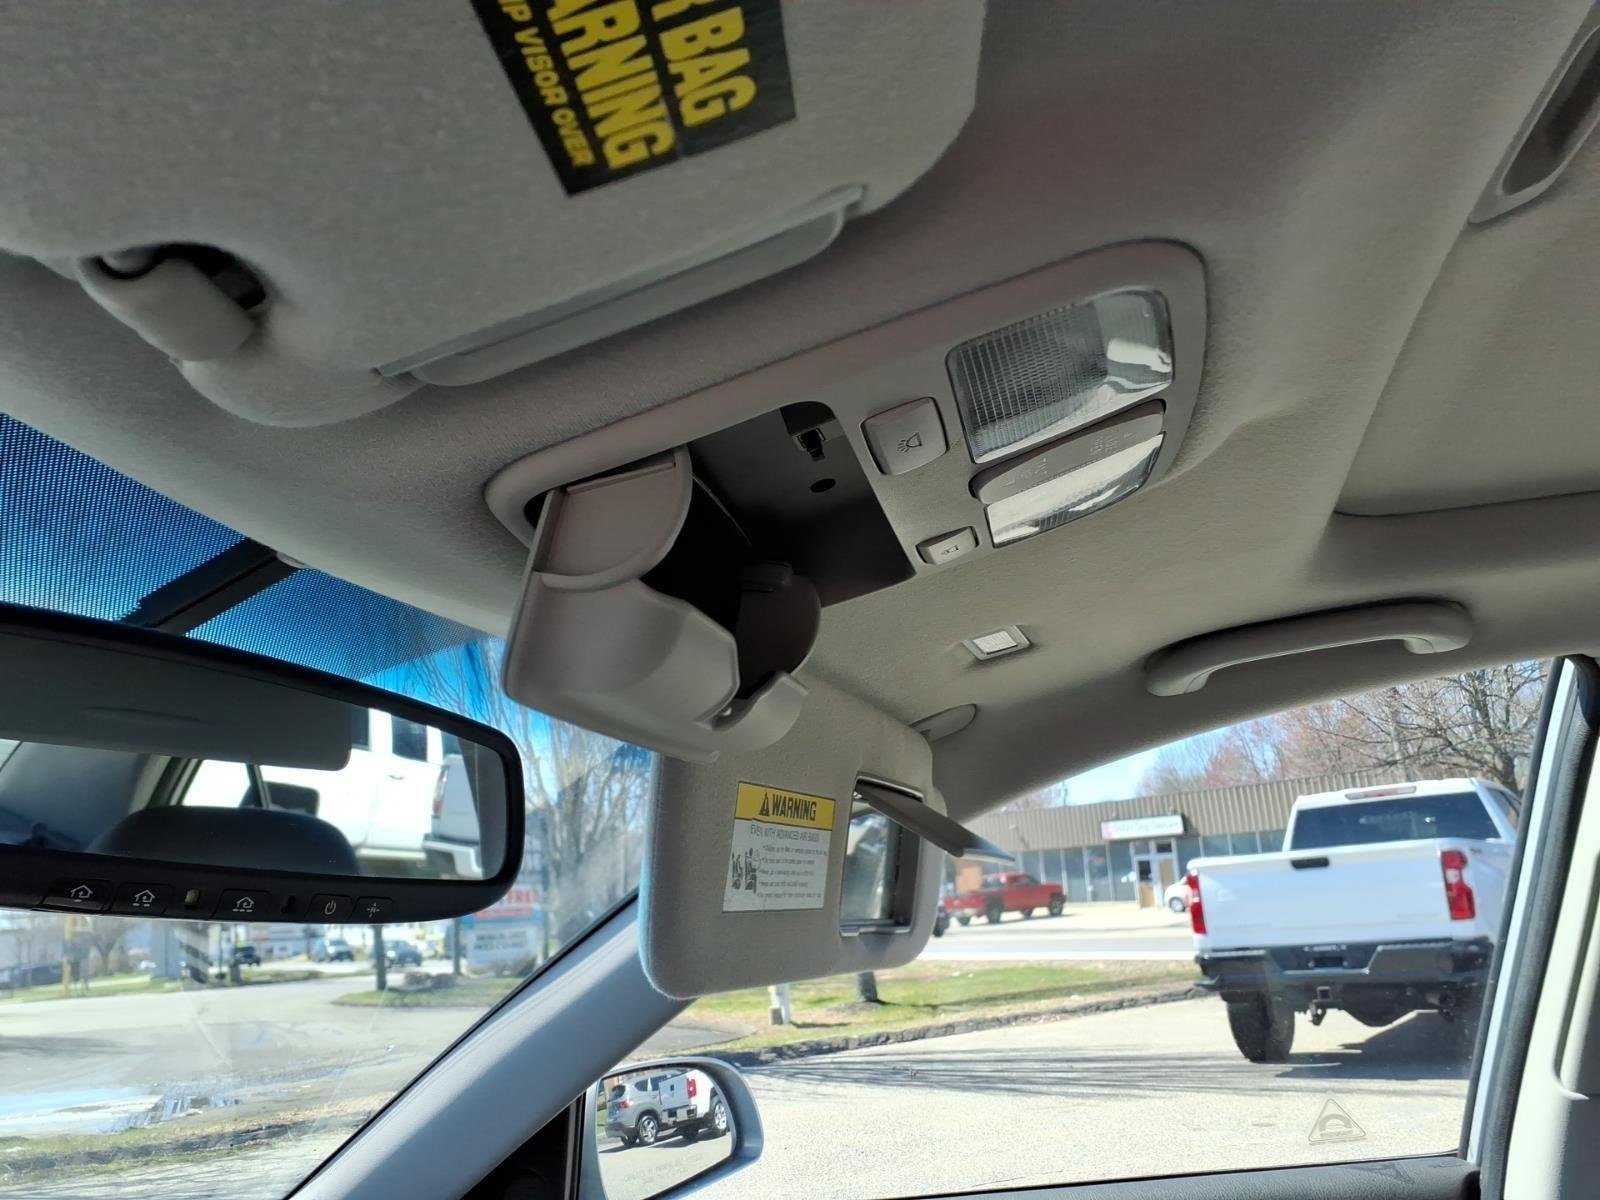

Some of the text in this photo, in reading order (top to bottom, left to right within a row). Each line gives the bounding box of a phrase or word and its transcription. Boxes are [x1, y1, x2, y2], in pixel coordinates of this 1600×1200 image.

[514, 26, 569, 106] VISOR
[551, 107, 596, 167] OVER
[659, 6, 757, 128] BAG
[772, 793, 817, 821] WARNING
